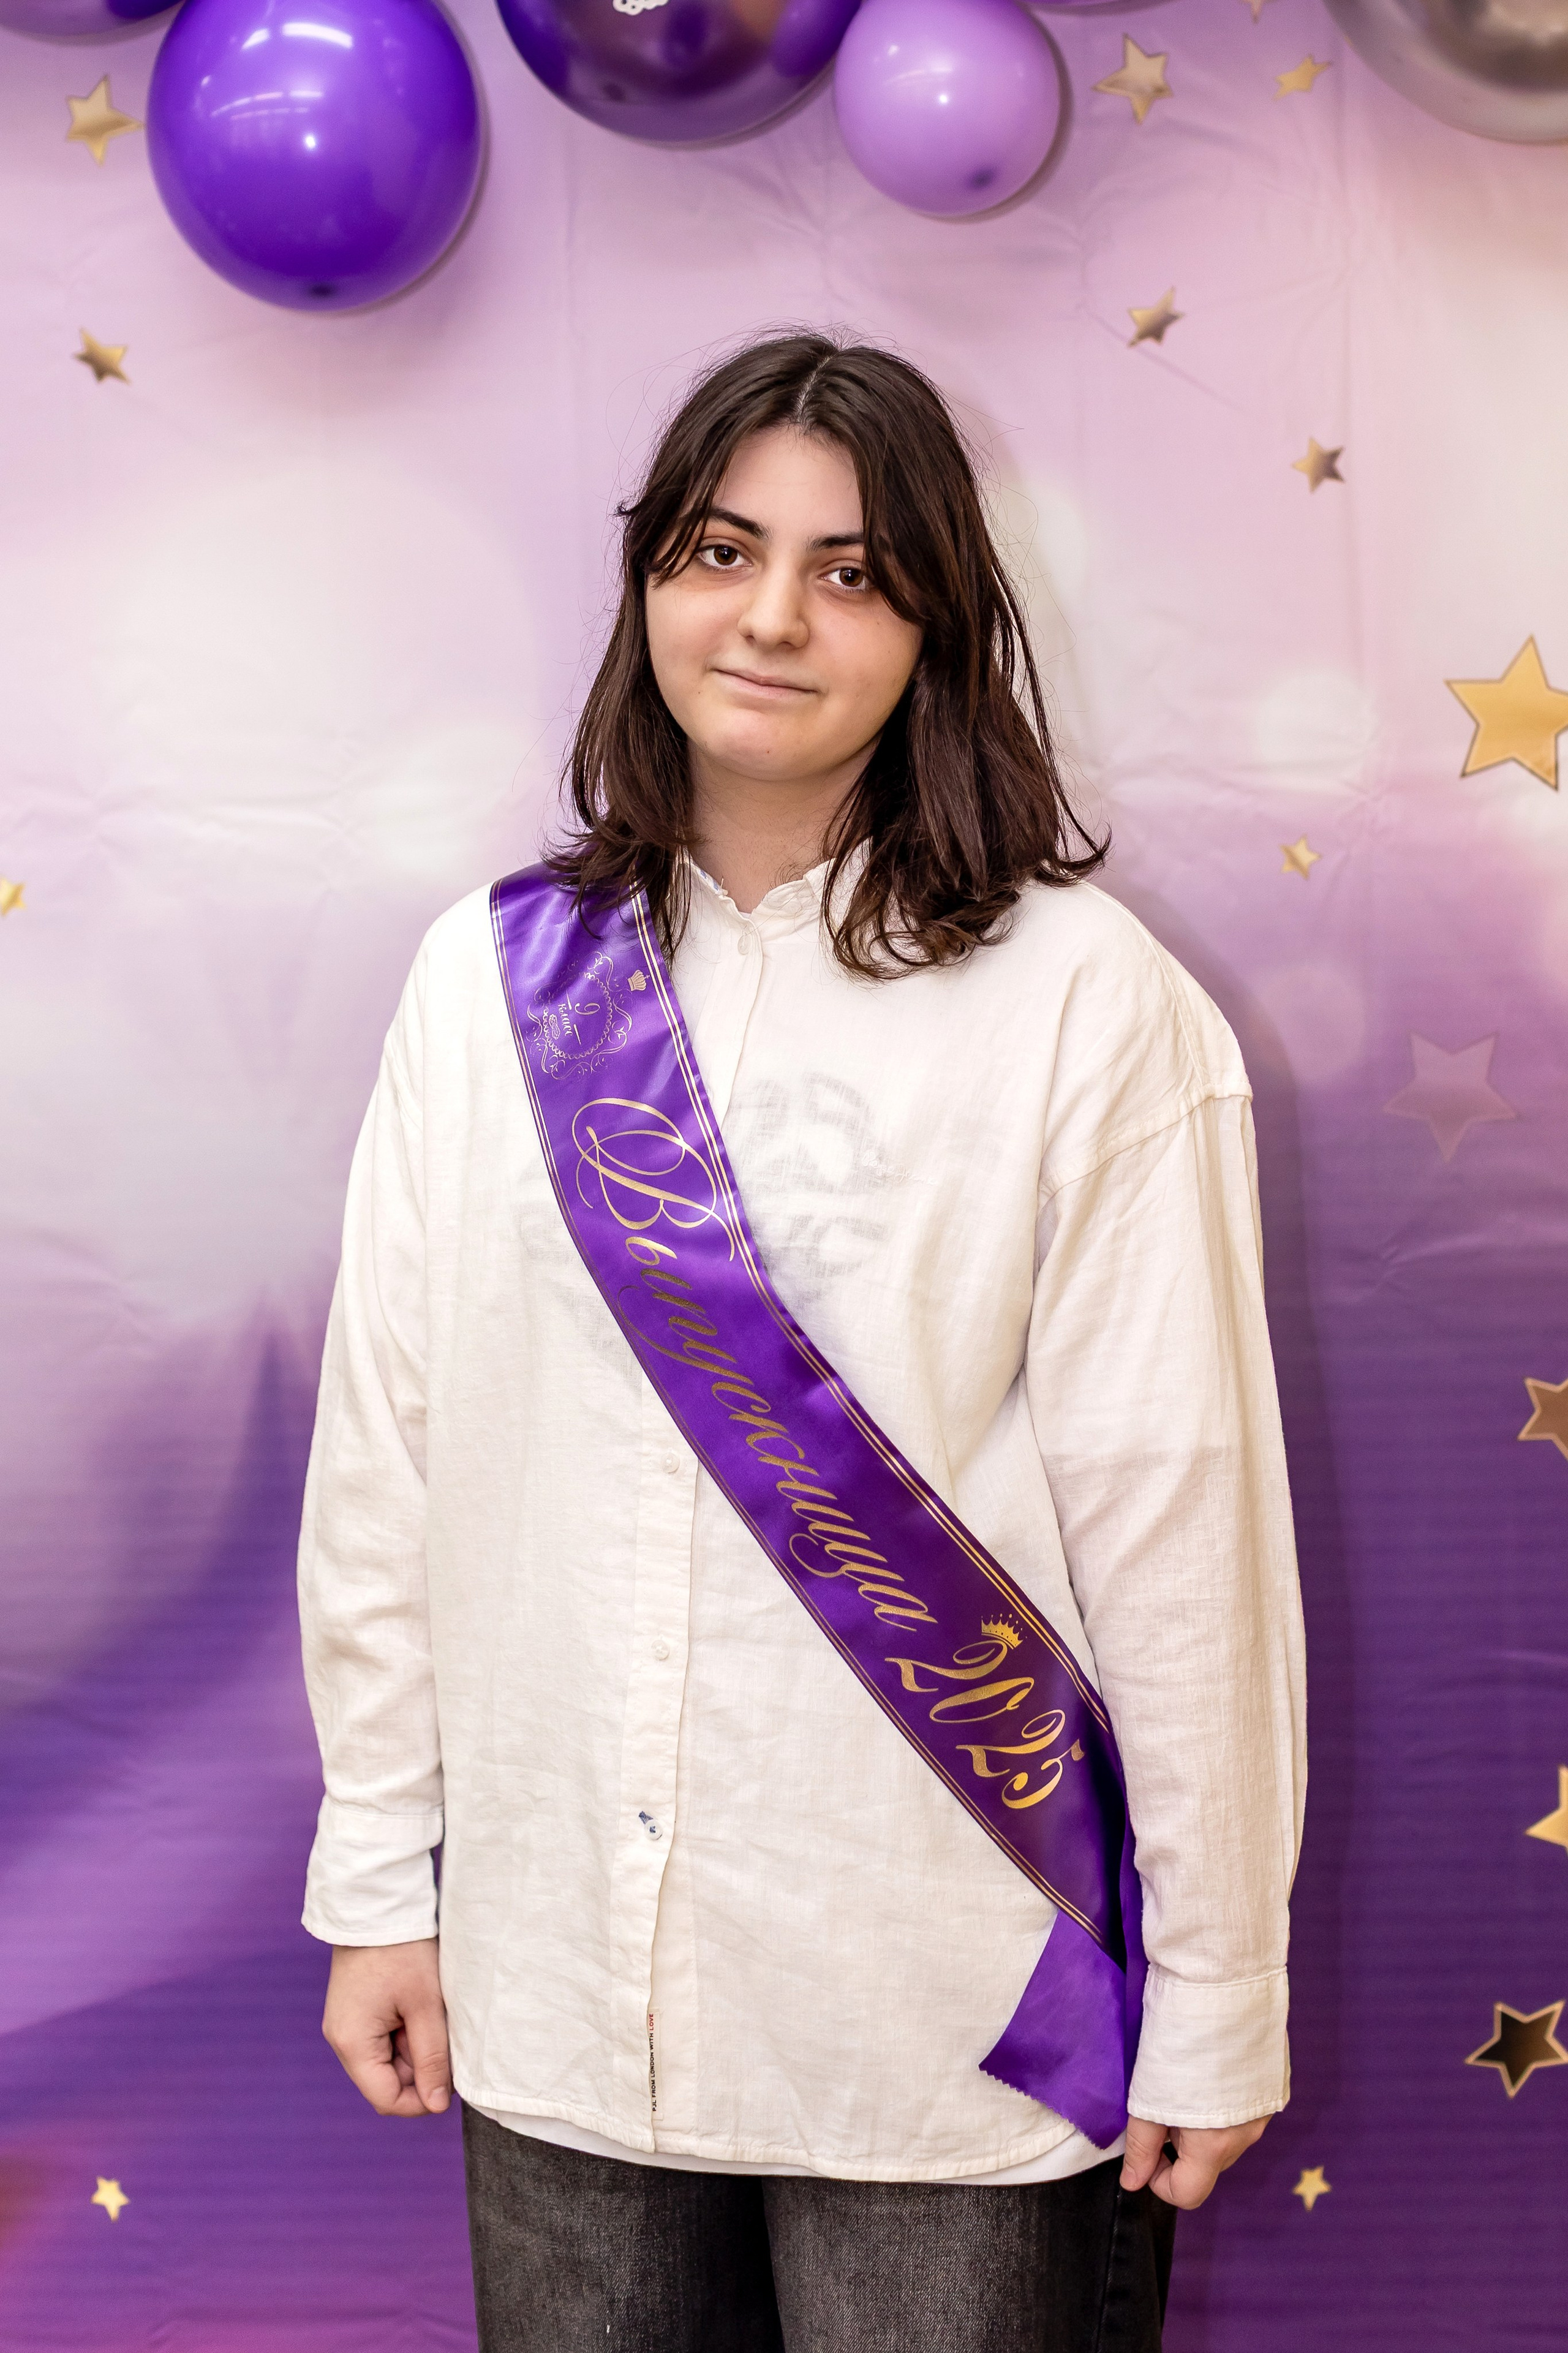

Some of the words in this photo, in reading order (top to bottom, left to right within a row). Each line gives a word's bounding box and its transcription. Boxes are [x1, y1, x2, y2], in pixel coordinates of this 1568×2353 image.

[575, 1003, 600, 1015] 9
[572, 1098, 938, 1631] Выпускница
[884, 1640, 1085, 1809] 2025
